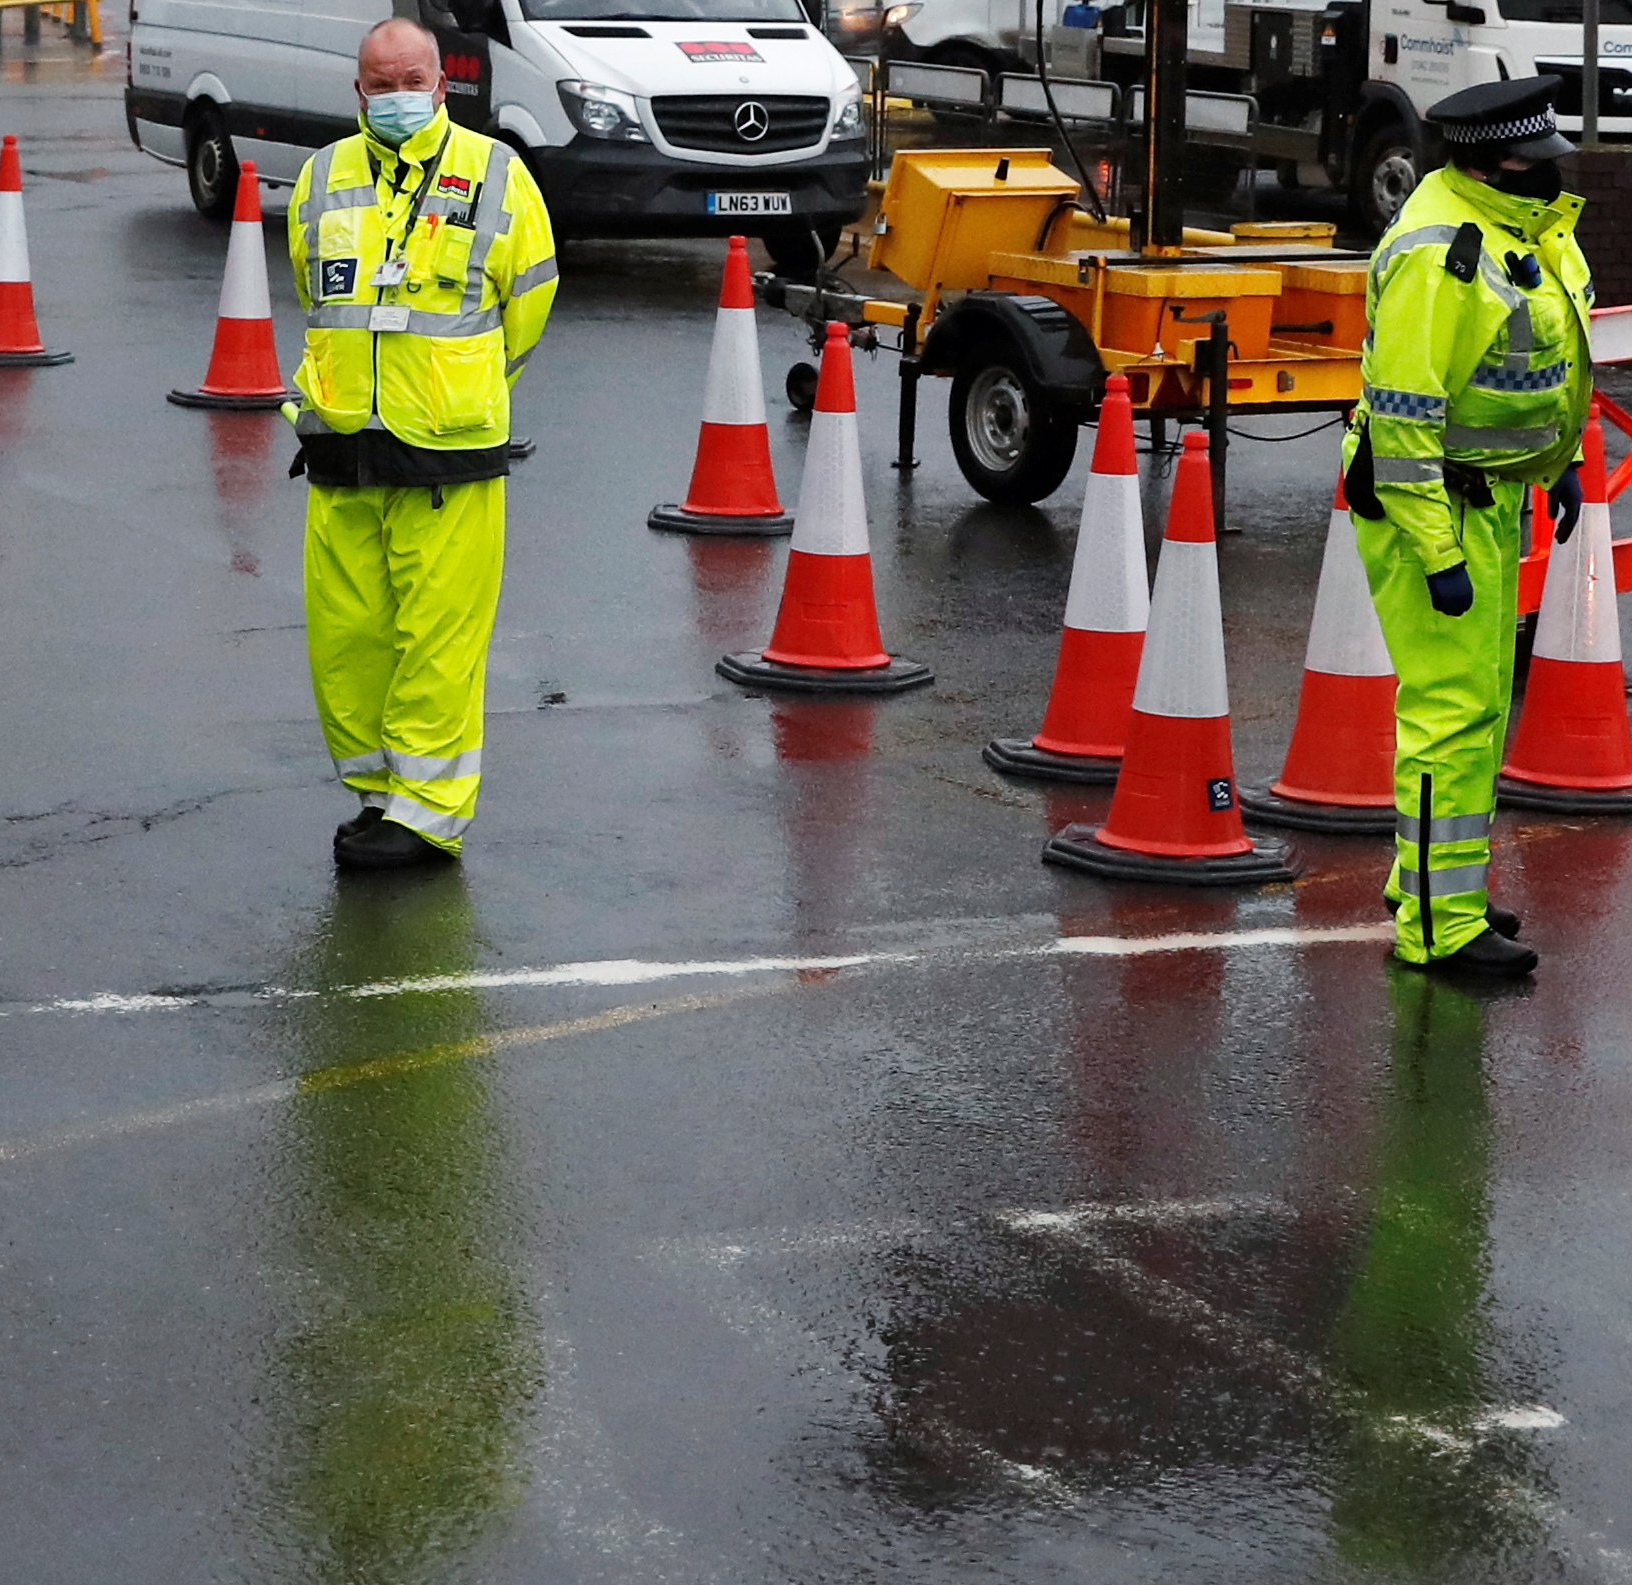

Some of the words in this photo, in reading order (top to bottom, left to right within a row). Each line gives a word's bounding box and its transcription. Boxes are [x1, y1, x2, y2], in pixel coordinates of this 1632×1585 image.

[689, 53, 763, 63] SECURITAS
[719, 196, 759, 212] LN63
[763, 195, 789, 212] WUW
